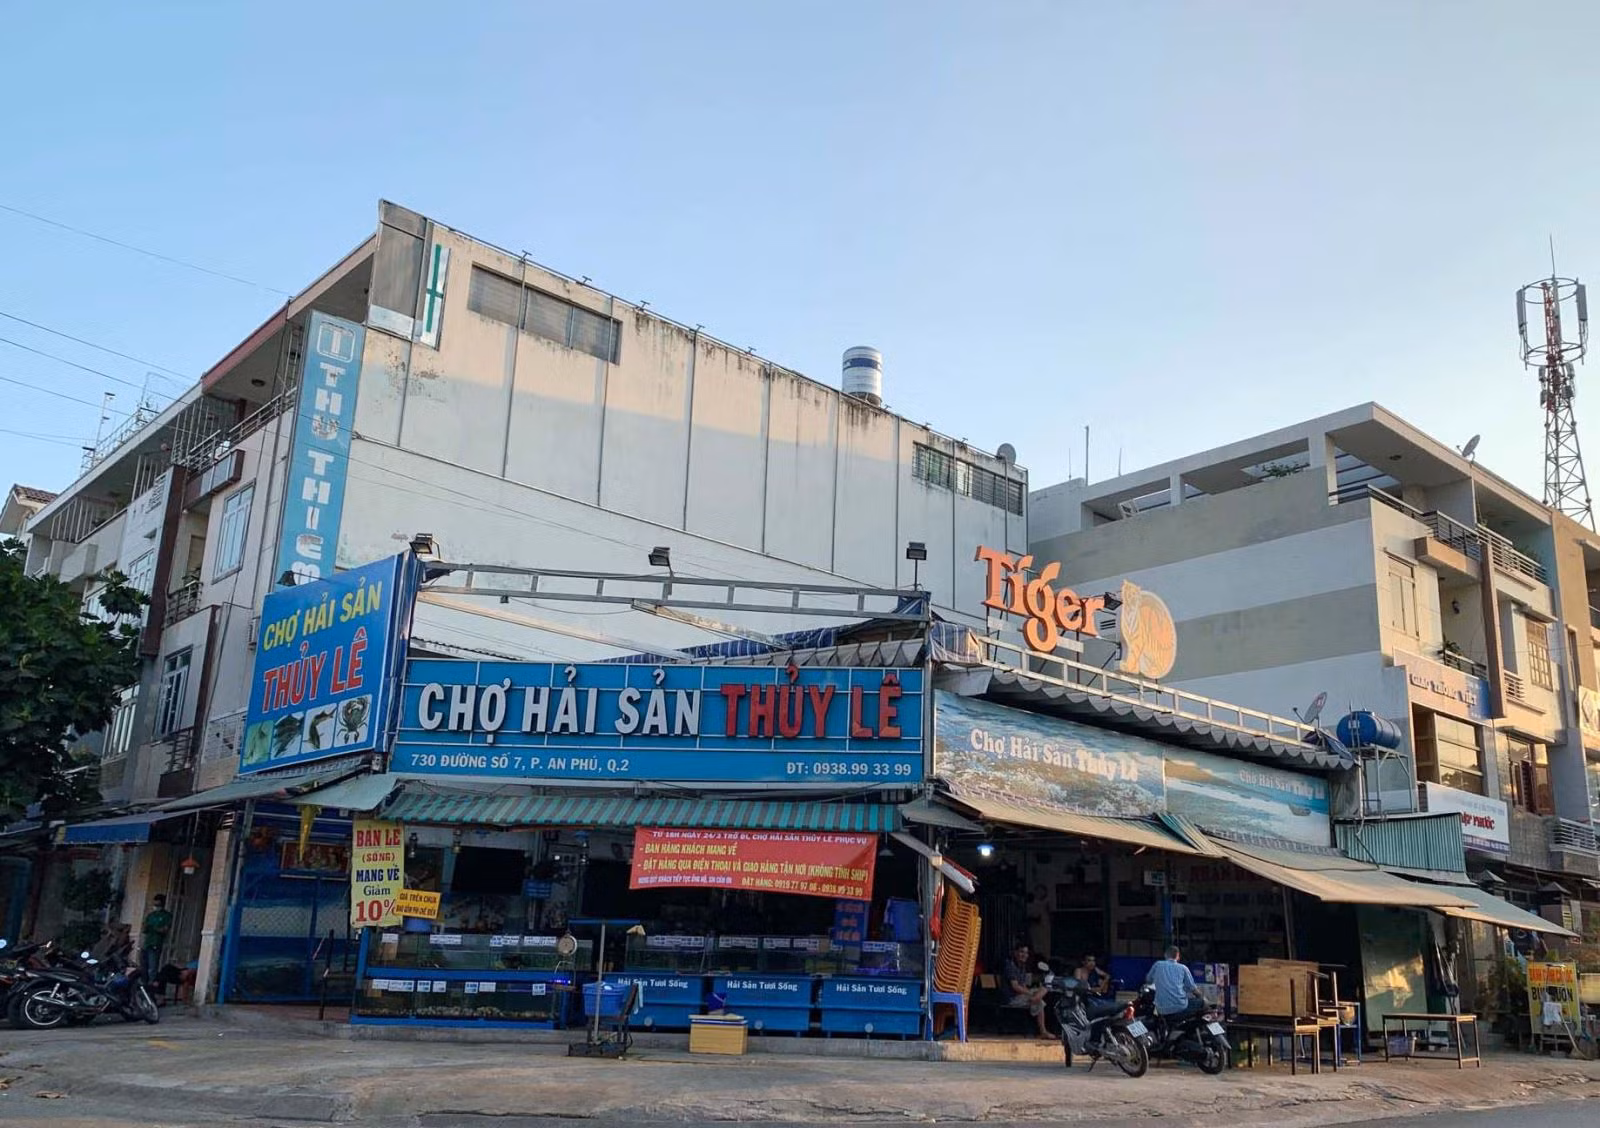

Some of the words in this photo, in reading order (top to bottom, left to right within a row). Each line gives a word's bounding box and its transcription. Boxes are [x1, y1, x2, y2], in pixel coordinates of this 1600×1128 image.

[264, 610, 300, 651] CHỢ
[302, 592, 335, 635] HẢI
[340, 577, 382, 623] SẢN
[974, 544, 1105, 654] Tiger
[262, 641, 328, 714] THỦY
[330, 626, 369, 696] LÊ
[418, 678, 512, 744] CHỢ
[520, 666, 598, 734] HẢI
[614, 668, 701, 736] SẢN
[721, 663, 836, 738] THỦY
[850, 674, 902, 738] LÊ
[410, 754, 436, 766] 730
[440, 751, 487, 768] ĐƯỜNG
[490, 752, 511, 769] SỐ
[514, 756, 526, 771] 7,
[530, 757, 542, 770] P.
[548, 758, 566, 770] AN
[570, 756, 602, 773] PHÚ,
[607, 759, 629, 772] Q.2
[970, 728, 1006, 759] Chợ
[1010, 736, 1039, 762] Hải
[1043, 744, 1072, 768] Sản
[787, 762, 808, 774] ĐT:
[813, 762, 868, 775] 0938.99
[872, 763, 889, 775] 33
[894, 764, 911, 776] 99
[356, 869, 384, 882] MANG
[356, 898, 396, 922] 10%
